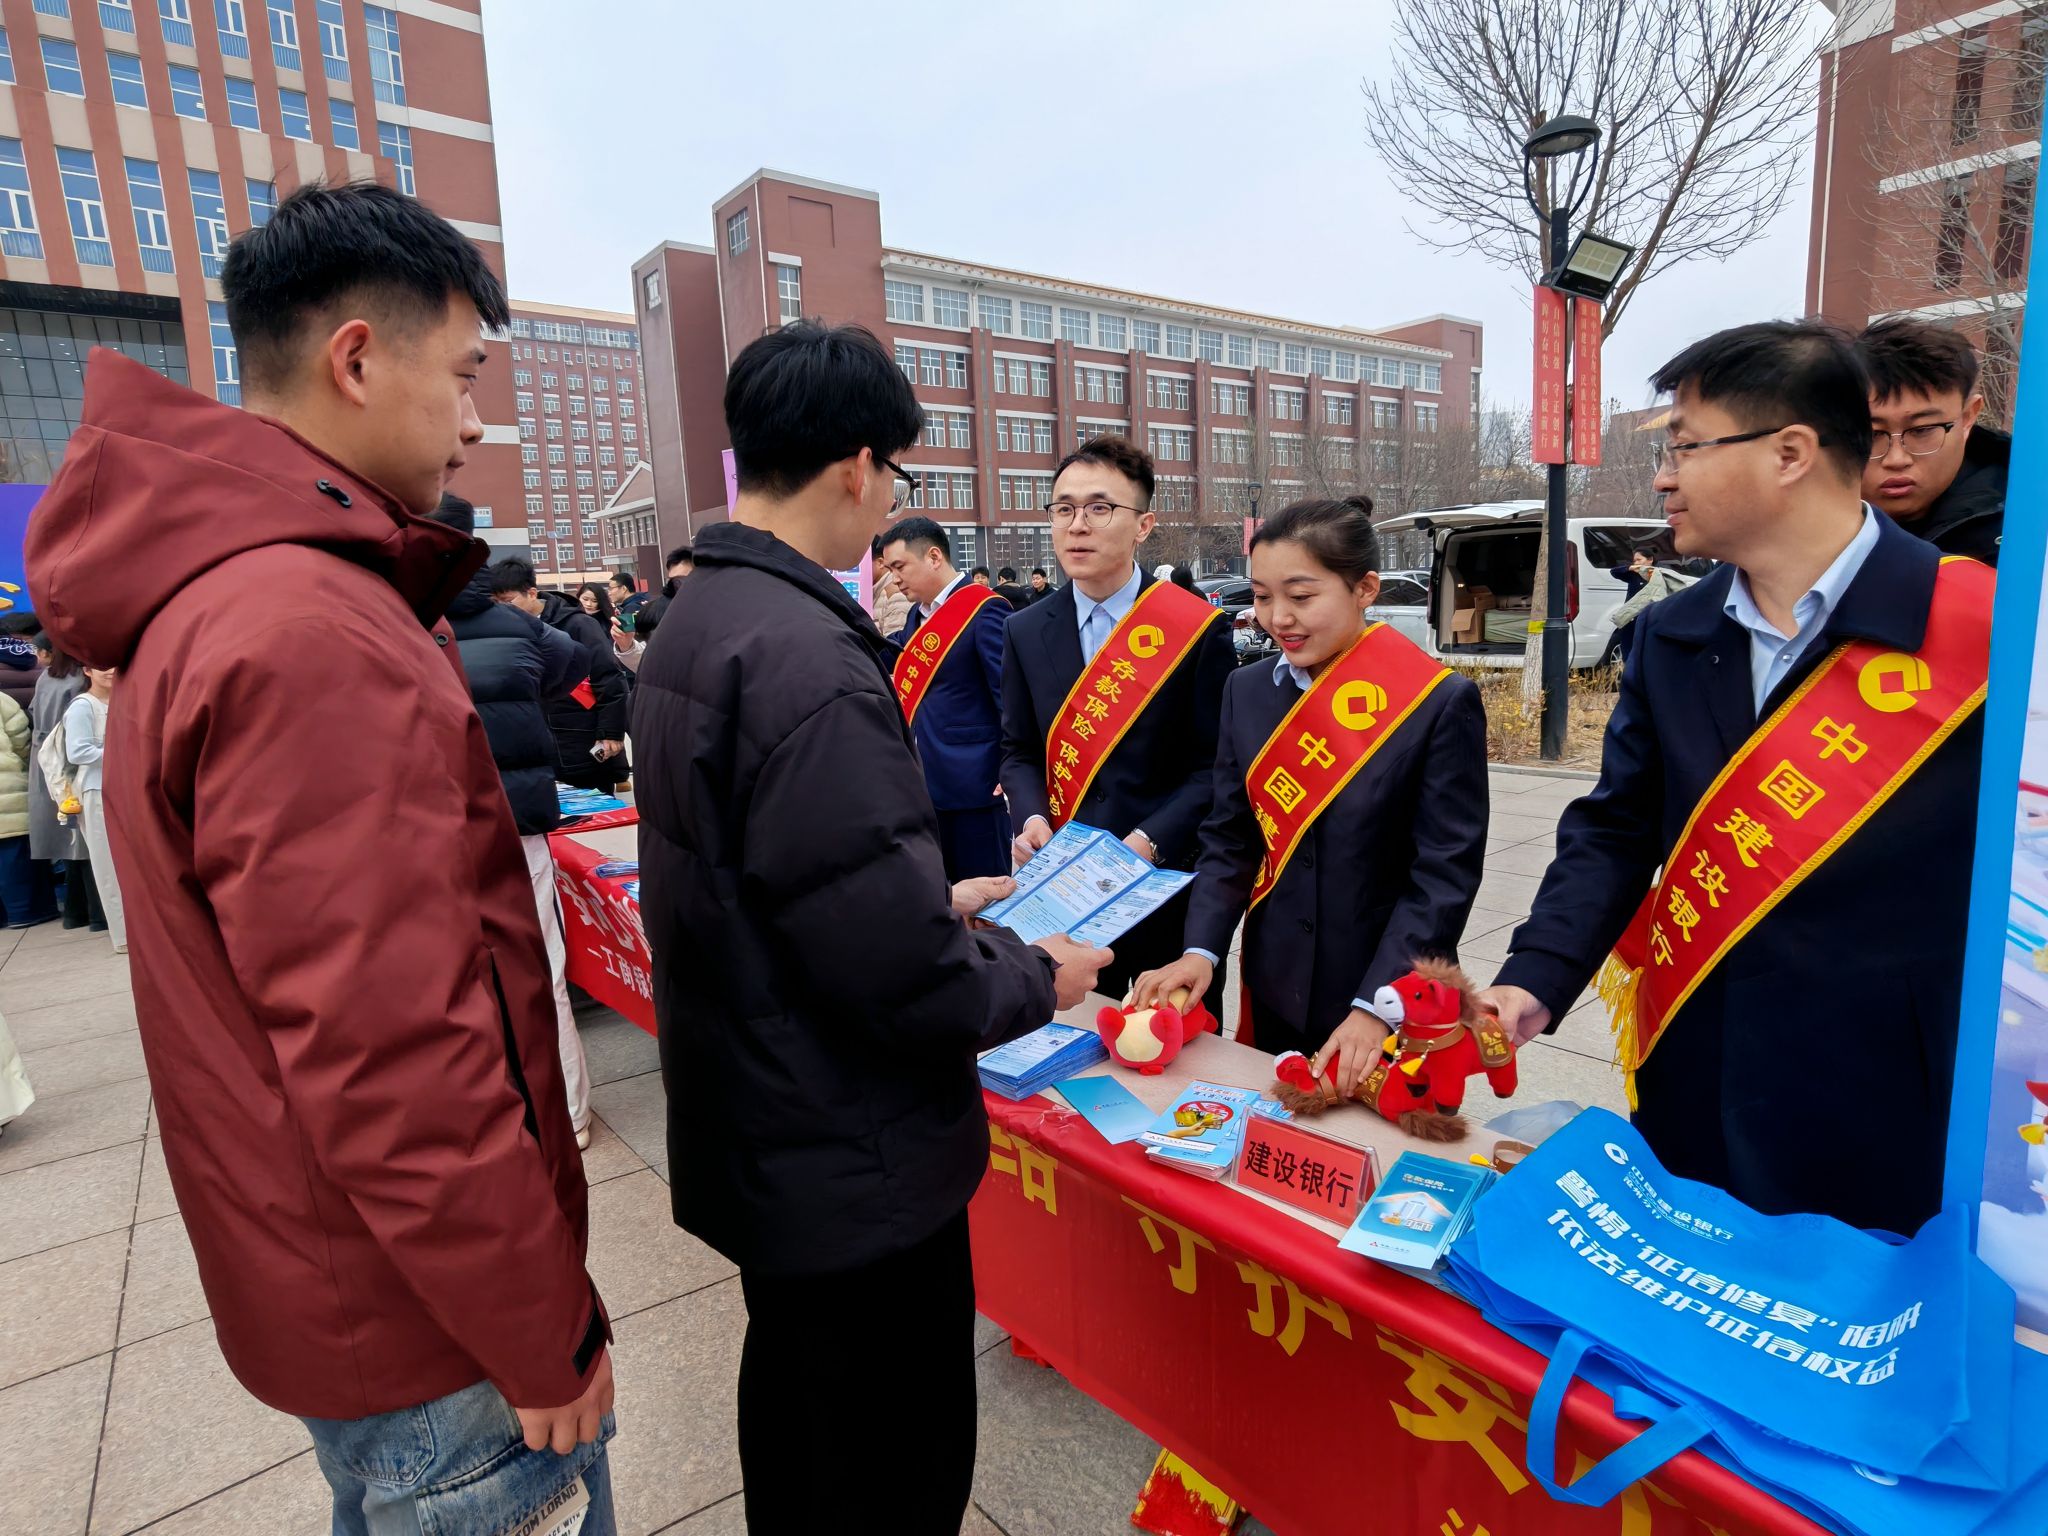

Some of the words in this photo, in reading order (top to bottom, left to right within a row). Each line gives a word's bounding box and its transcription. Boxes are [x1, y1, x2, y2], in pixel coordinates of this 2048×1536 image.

[911, 645, 933, 667] ICBC
[1254, 731, 1336, 888] 中国建
[1650, 716, 1868, 966] 中国建设银行
[1245, 1141, 1354, 1208] 建设银行
[1631, 1166, 1734, 1240] 中国建设银行
[1547, 1209, 1899, 1385] 依法维护征信权益
[540, 1483, 578, 1520] LORND
